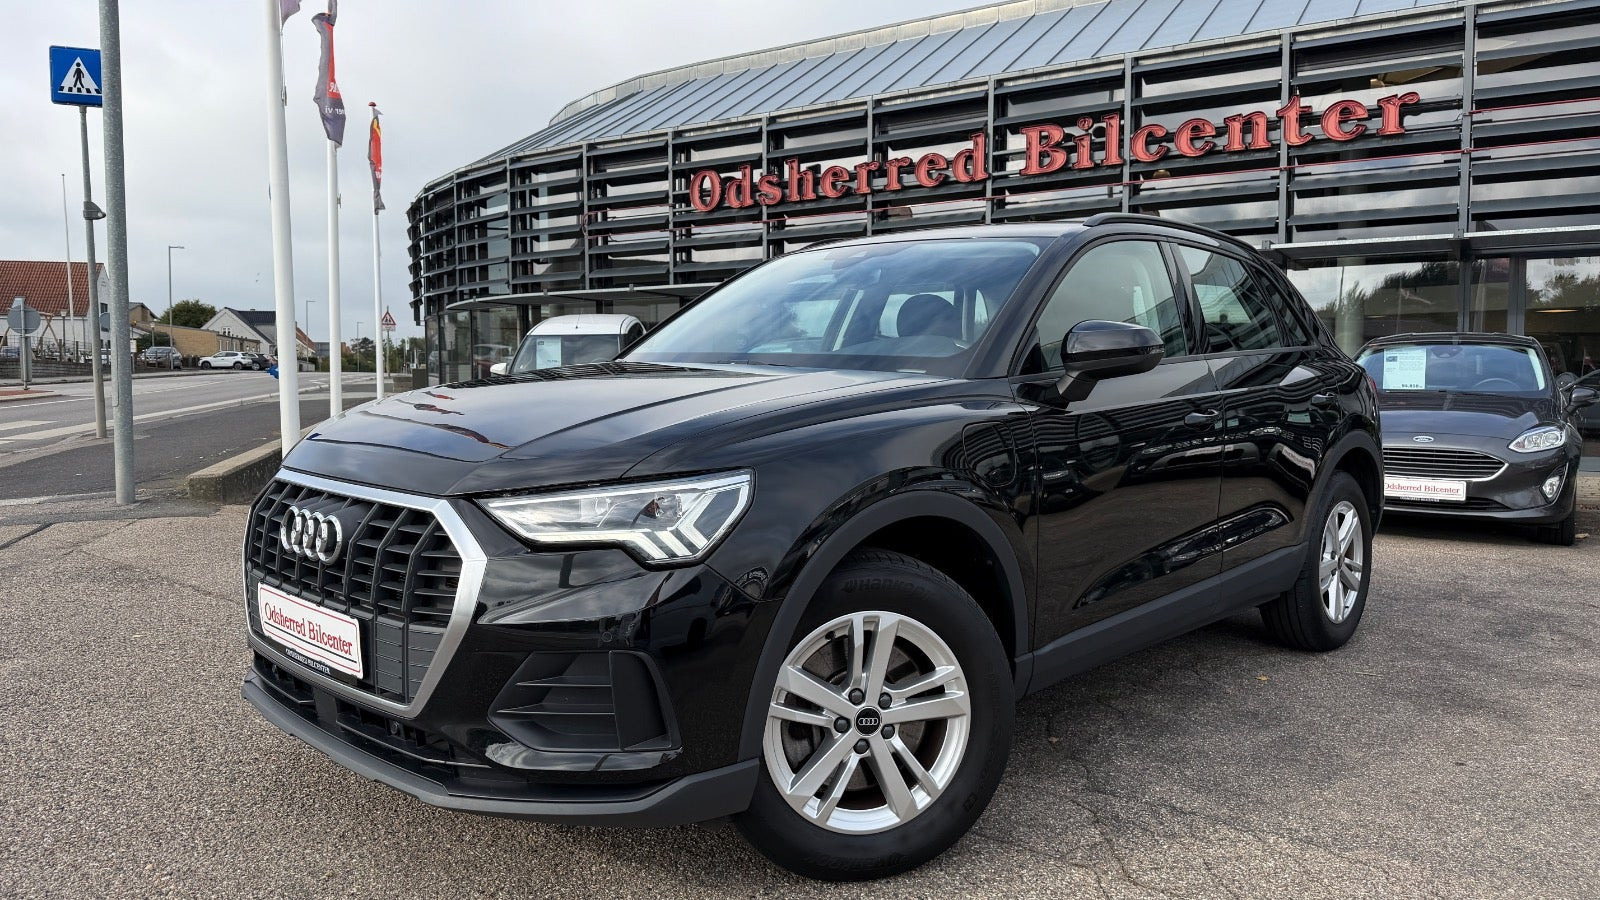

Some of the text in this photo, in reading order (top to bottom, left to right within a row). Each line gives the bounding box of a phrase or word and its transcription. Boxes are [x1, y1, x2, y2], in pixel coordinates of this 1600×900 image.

[690, 91, 1420, 212] Odsherred Bilcenter
[1424, 484, 1461, 494] Bilcenter
[264, 602, 306, 637] Odsherred
[307, 620, 353, 656] Bilcenter
